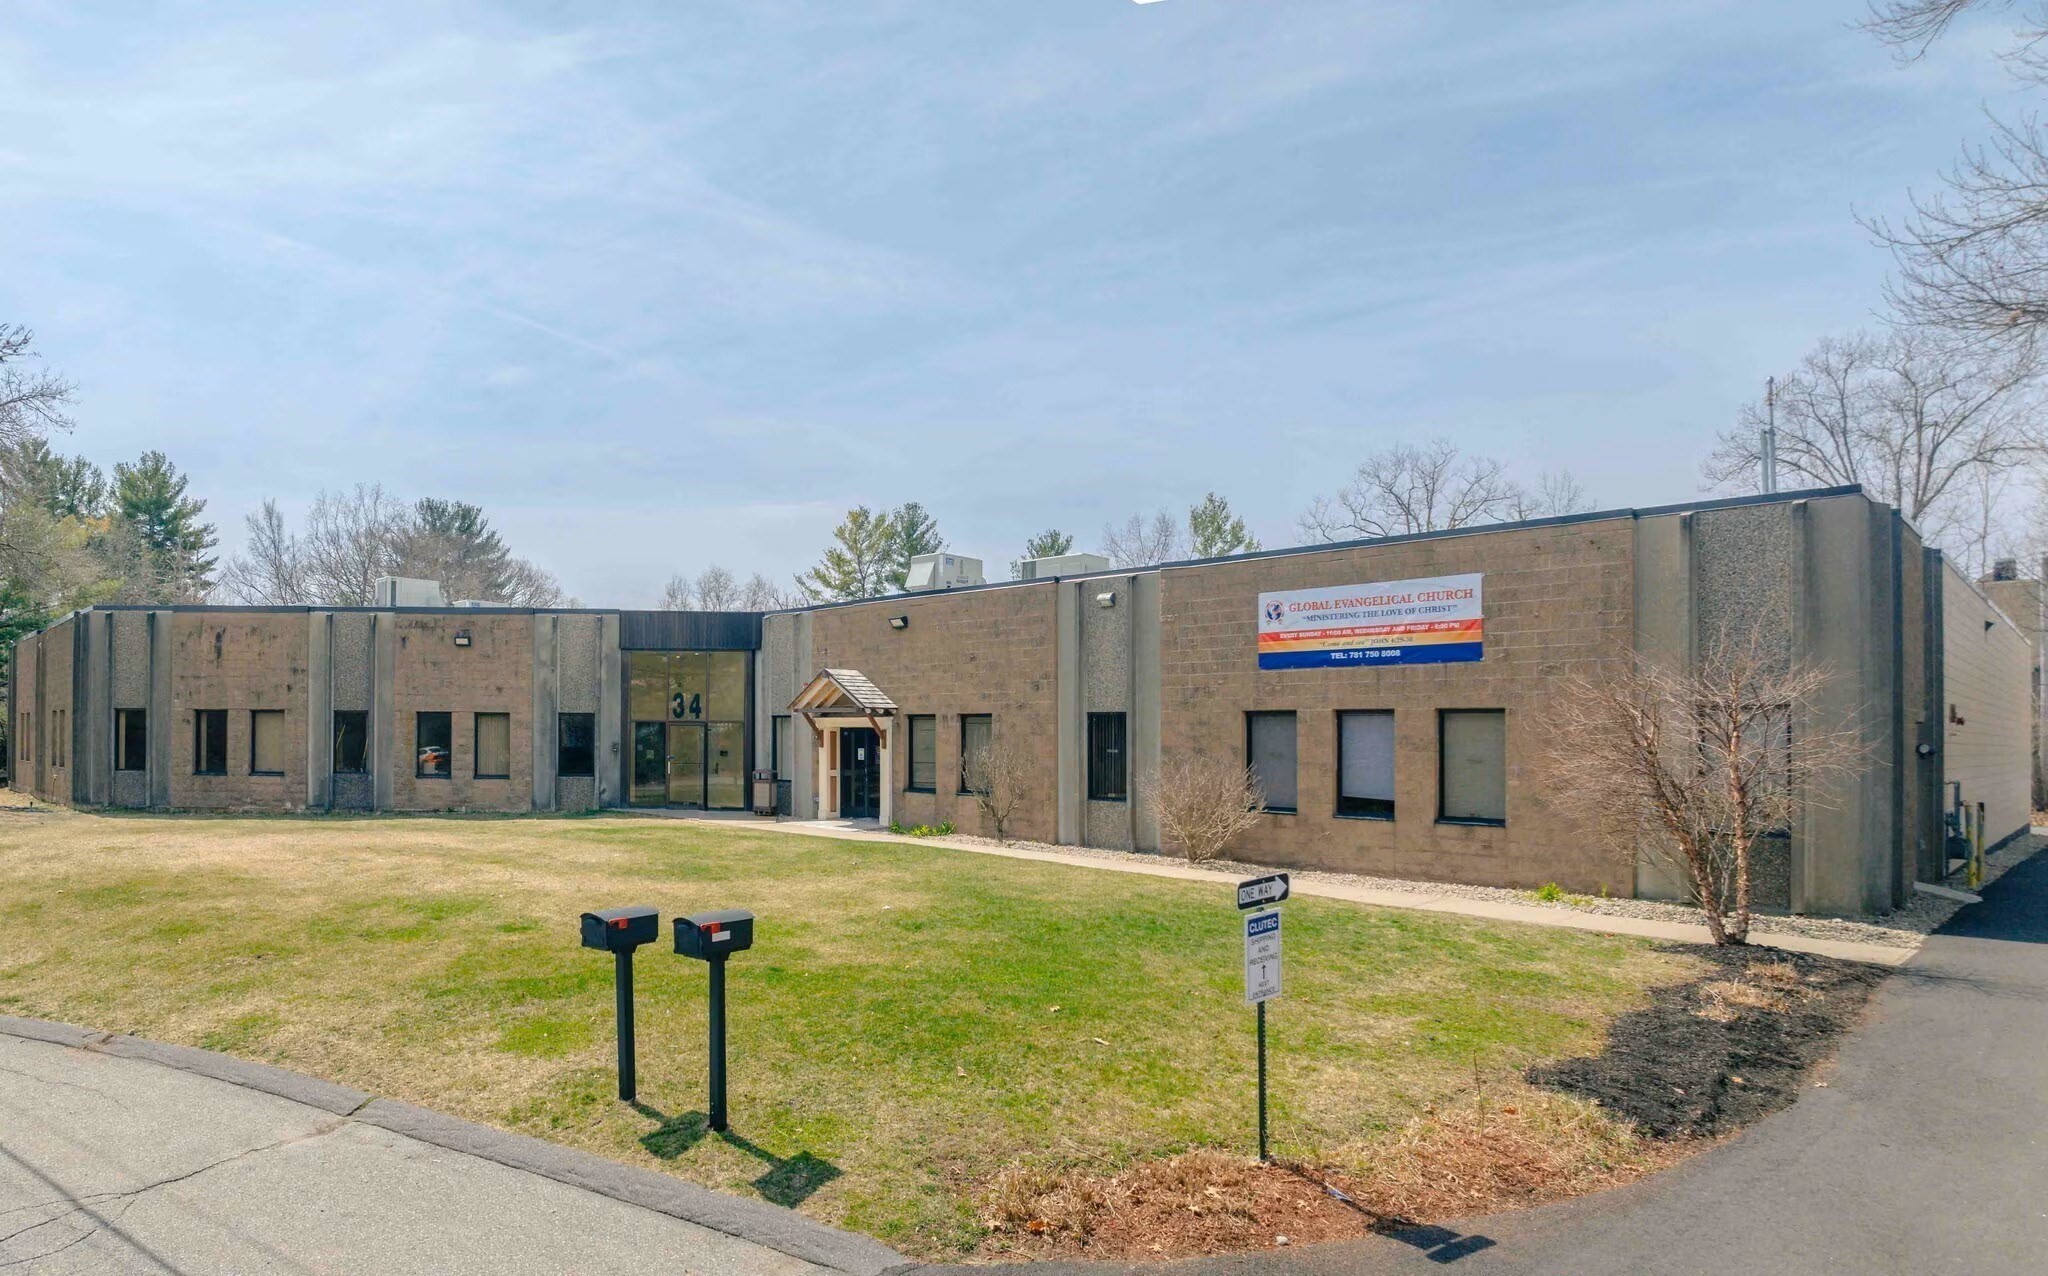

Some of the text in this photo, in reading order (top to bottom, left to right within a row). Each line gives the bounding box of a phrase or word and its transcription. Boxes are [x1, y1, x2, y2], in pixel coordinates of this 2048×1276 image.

[1289, 588, 1473, 613] GLOBAL EVANGELICAL CHURCH
[1361, 610, 1379, 618] THE
[1381, 608, 1403, 617] LOVE
[1405, 607, 1416, 615] OF
[1354, 626, 1391, 634] WEDNESDAY
[672, 692, 702, 719] 34
[1241, 884, 1273, 901] ONE WAY
[1249, 917, 1278, 933] CLUTEC
